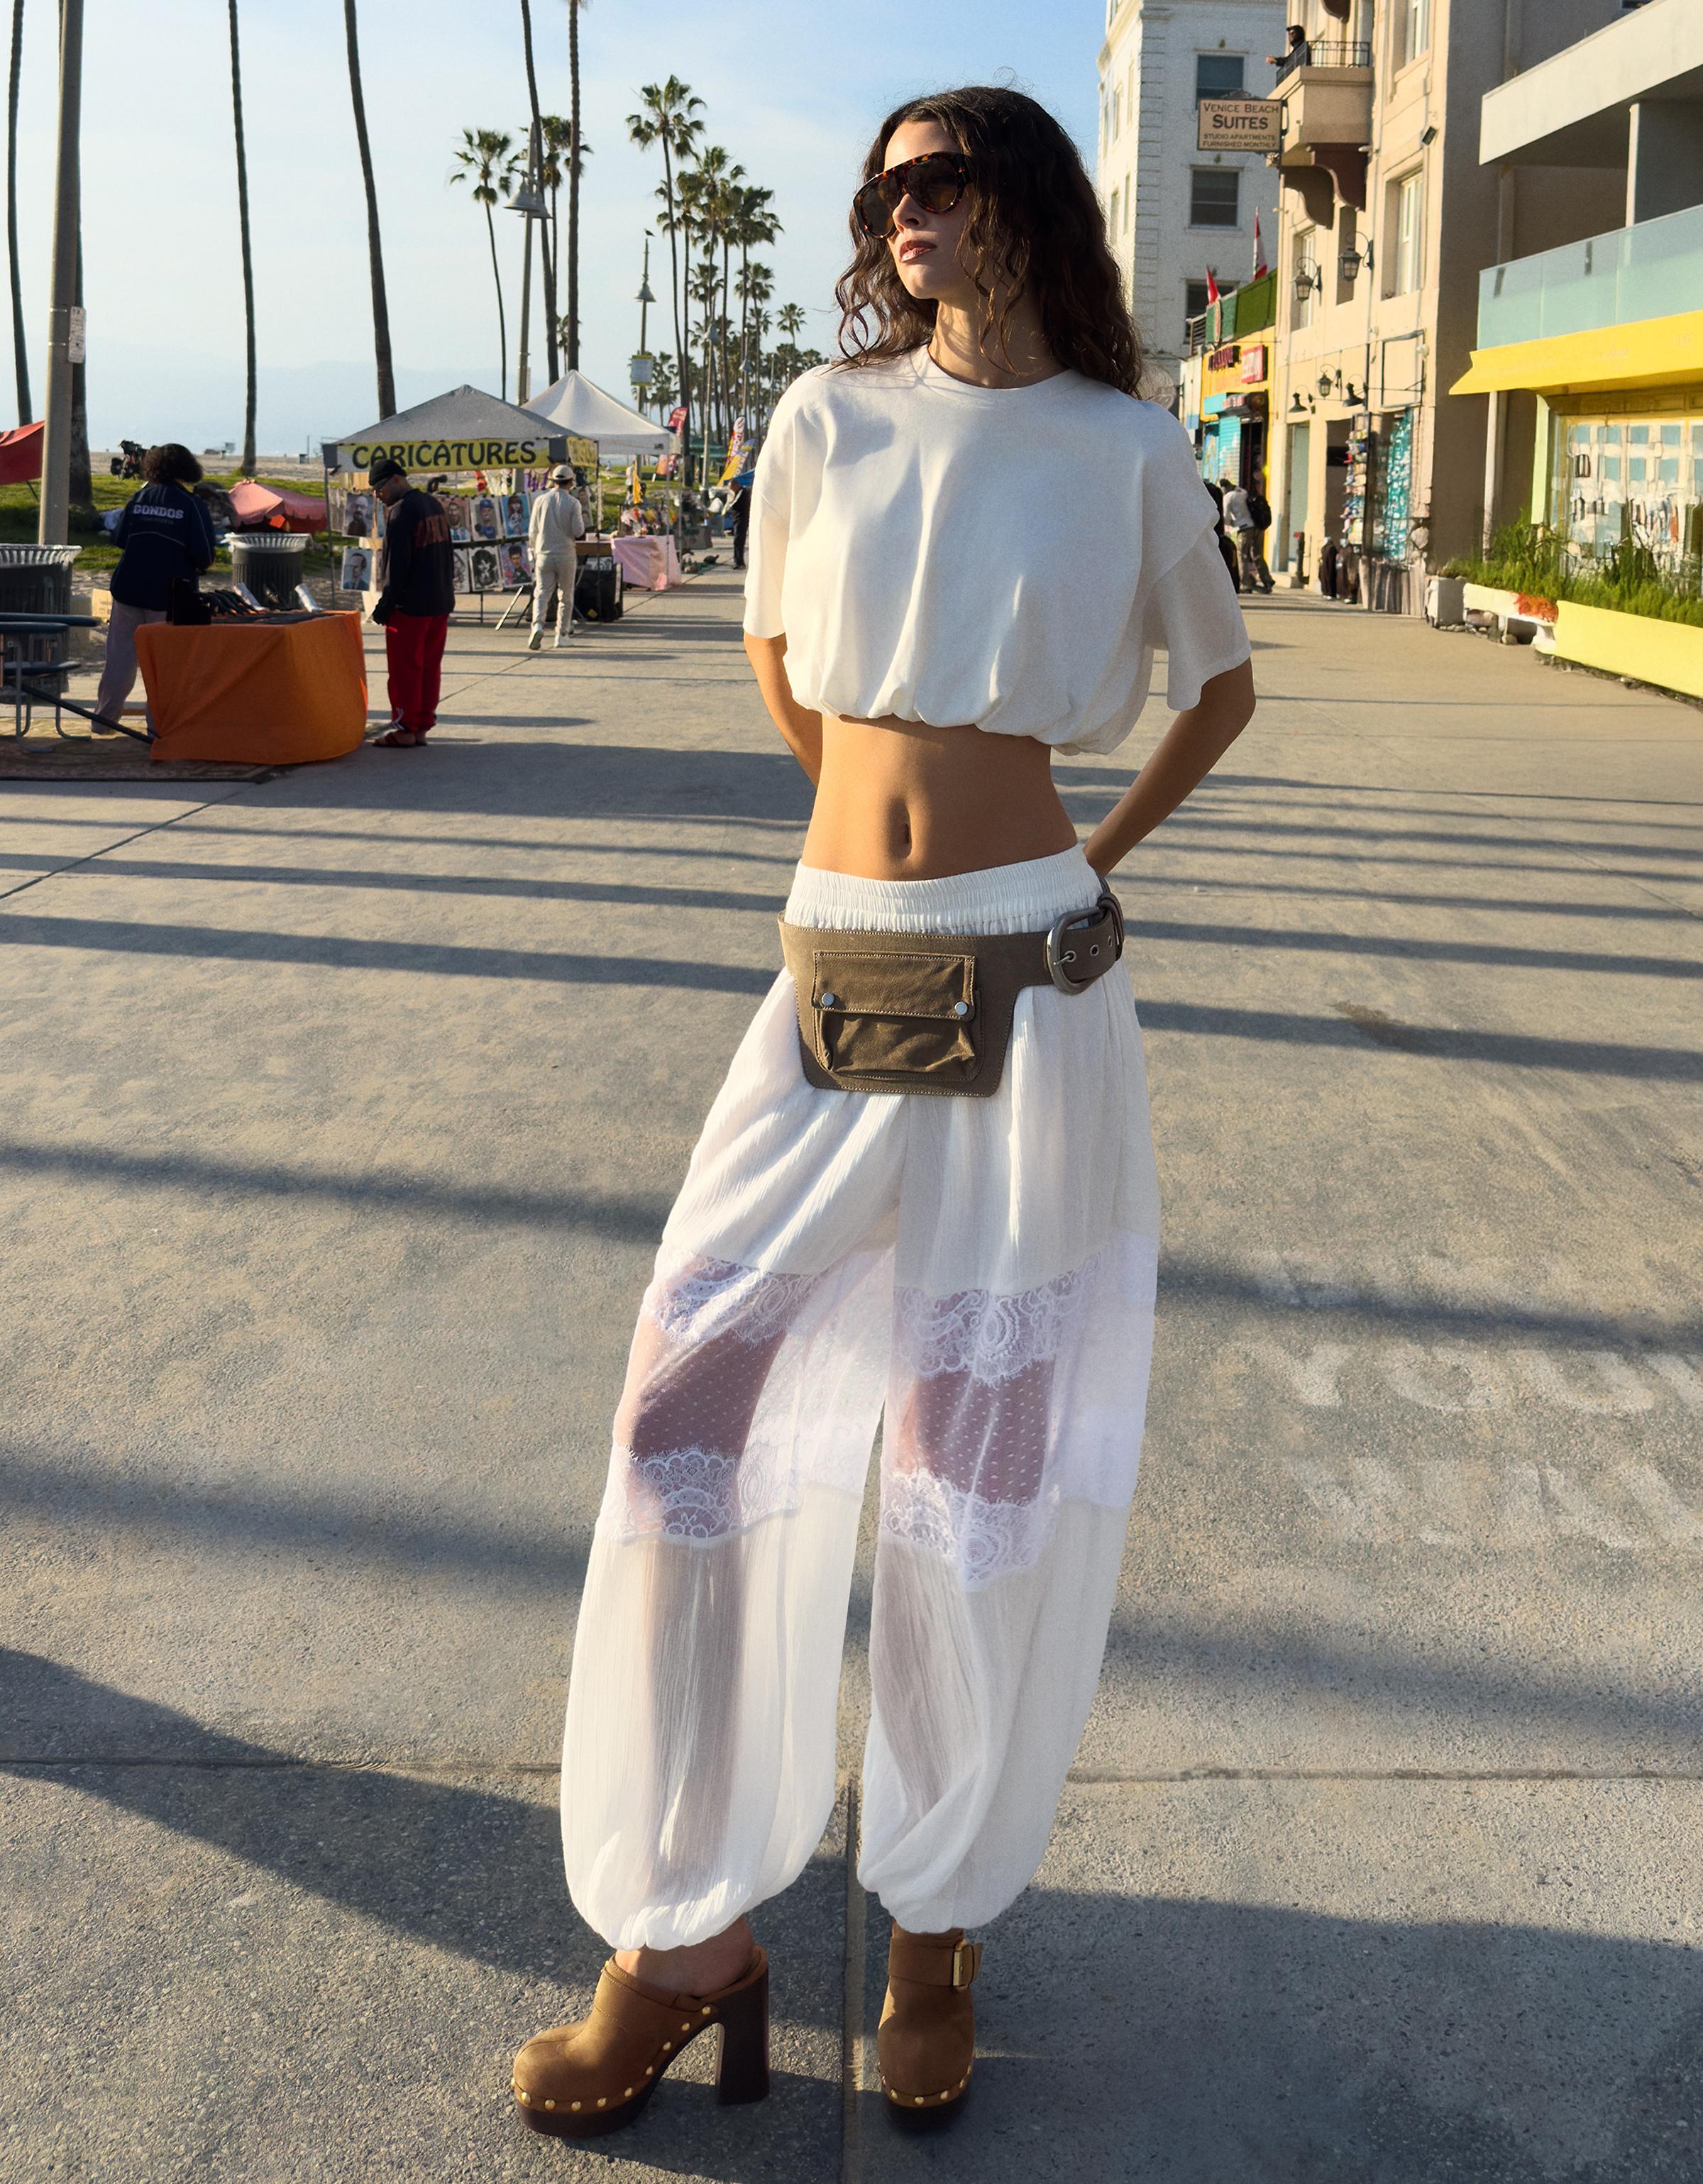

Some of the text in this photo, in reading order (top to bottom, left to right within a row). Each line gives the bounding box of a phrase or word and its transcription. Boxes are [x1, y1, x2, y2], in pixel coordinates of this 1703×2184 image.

[1203, 102, 1279, 114] VENICE BEACH
[1213, 114, 1269, 130] SUITES
[352, 441, 536, 469] CARICATURES
